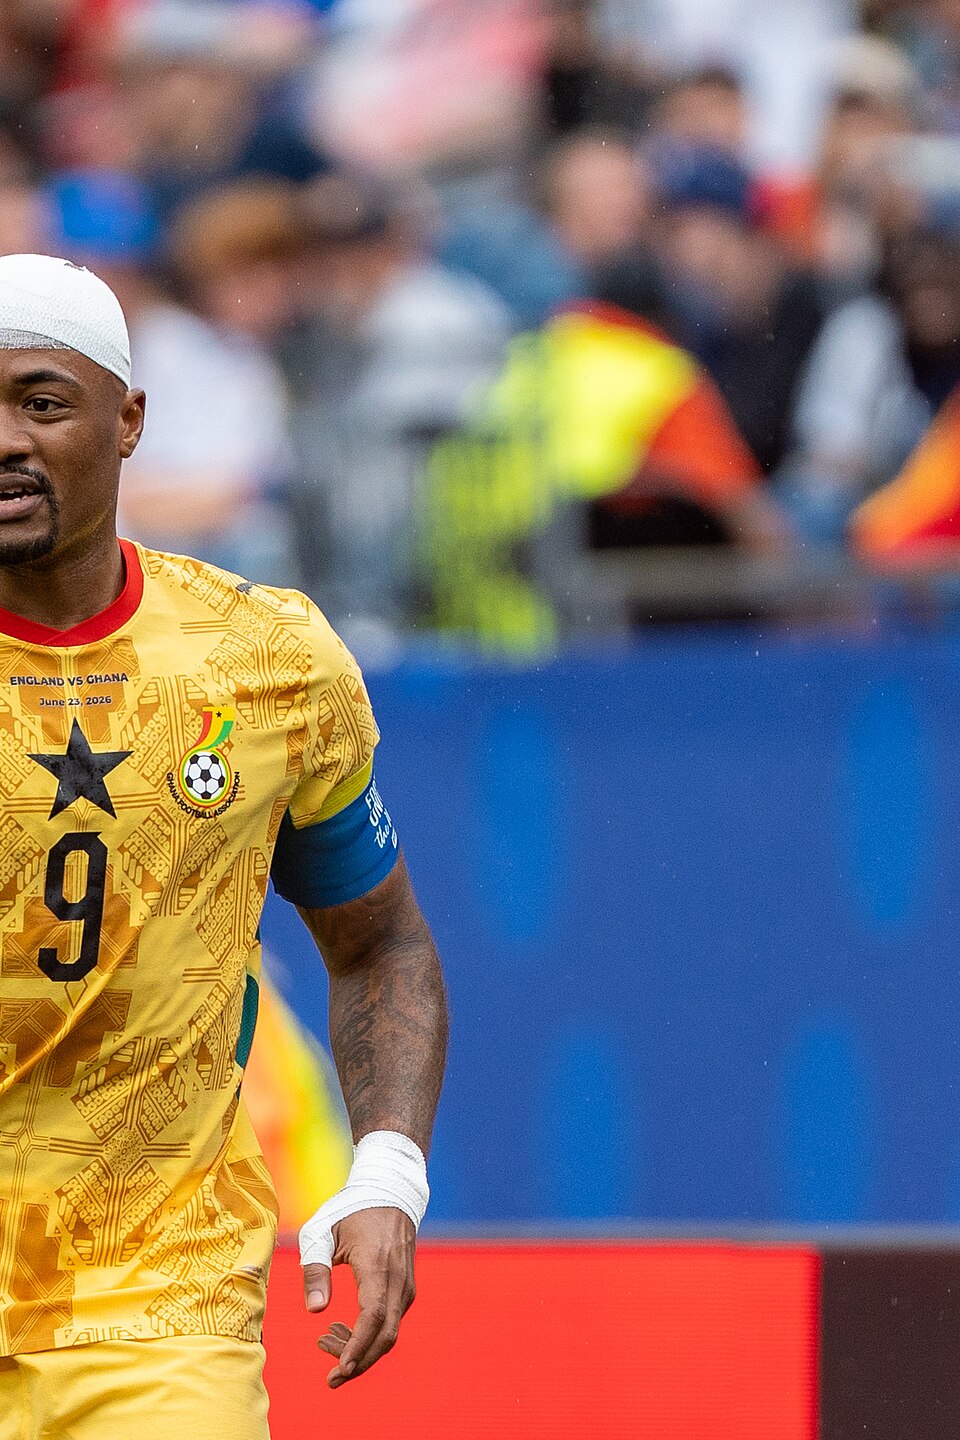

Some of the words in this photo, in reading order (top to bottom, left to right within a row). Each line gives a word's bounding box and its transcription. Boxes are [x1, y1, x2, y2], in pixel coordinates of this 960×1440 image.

[10, 676, 65, 686] ENGLAND
[67, 676, 84, 686] VS
[86, 672, 129, 684] GHANA
[40, 697, 65, 706] June
[68, 697, 83, 707] 23,
[86, 695, 112, 705] 2026
[166, 772, 181, 803] GHANA
[179, 799, 213, 819] FOOTBALL
[212, 771, 241, 817] ASSOCIATION
[38, 832, 109, 982] 9
